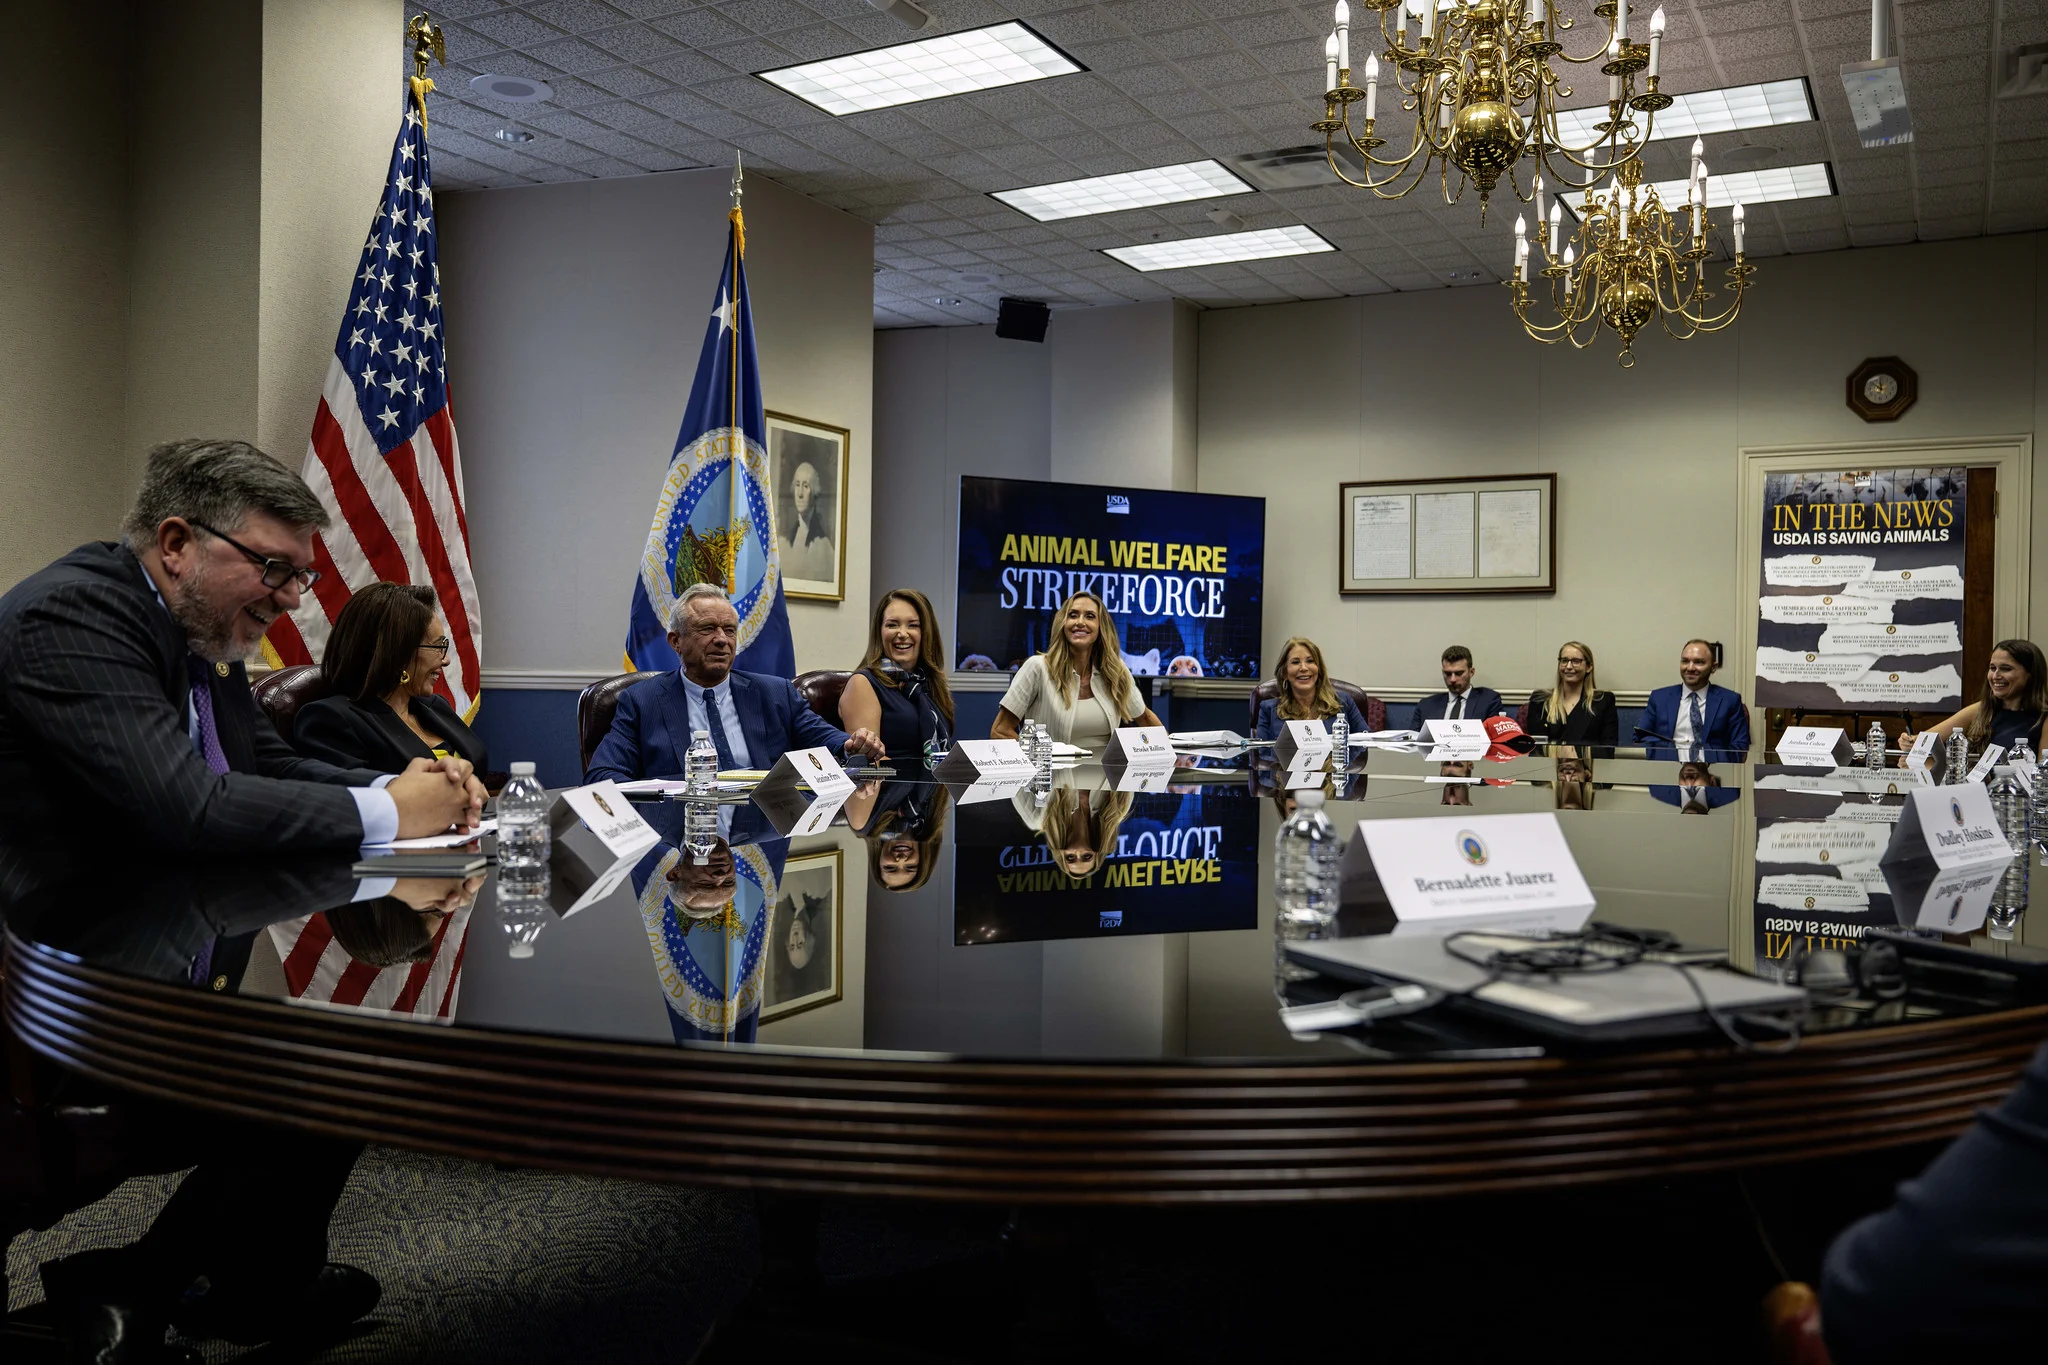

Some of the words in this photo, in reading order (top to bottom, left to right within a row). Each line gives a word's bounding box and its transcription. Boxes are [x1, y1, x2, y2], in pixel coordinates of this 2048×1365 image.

[650, 463, 690, 531] UNITED
[1107, 495, 1130, 505] USDA
[1773, 505, 1803, 531] IN
[1810, 503, 1865, 531] THE
[1872, 499, 1954, 530] NEWS
[1773, 533, 1811, 546] USDA
[1814, 532, 1827, 545] IS
[1829, 531, 1881, 545] SAVING
[1883, 529, 1950, 544] ANIMALS
[1000, 534, 1105, 567] ANIMAL
[1110, 540, 1227, 574] WELFARE
[1000, 567, 1226, 619] STRIKEFORCE
[999, 758, 1023, 766] Kennedy
[1936, 830, 1965, 847] Dudley
[1962, 826, 1994, 842] Hoskins
[1414, 872, 1503, 892] Bernadette
[1505, 870, 1555, 886] Juarez
